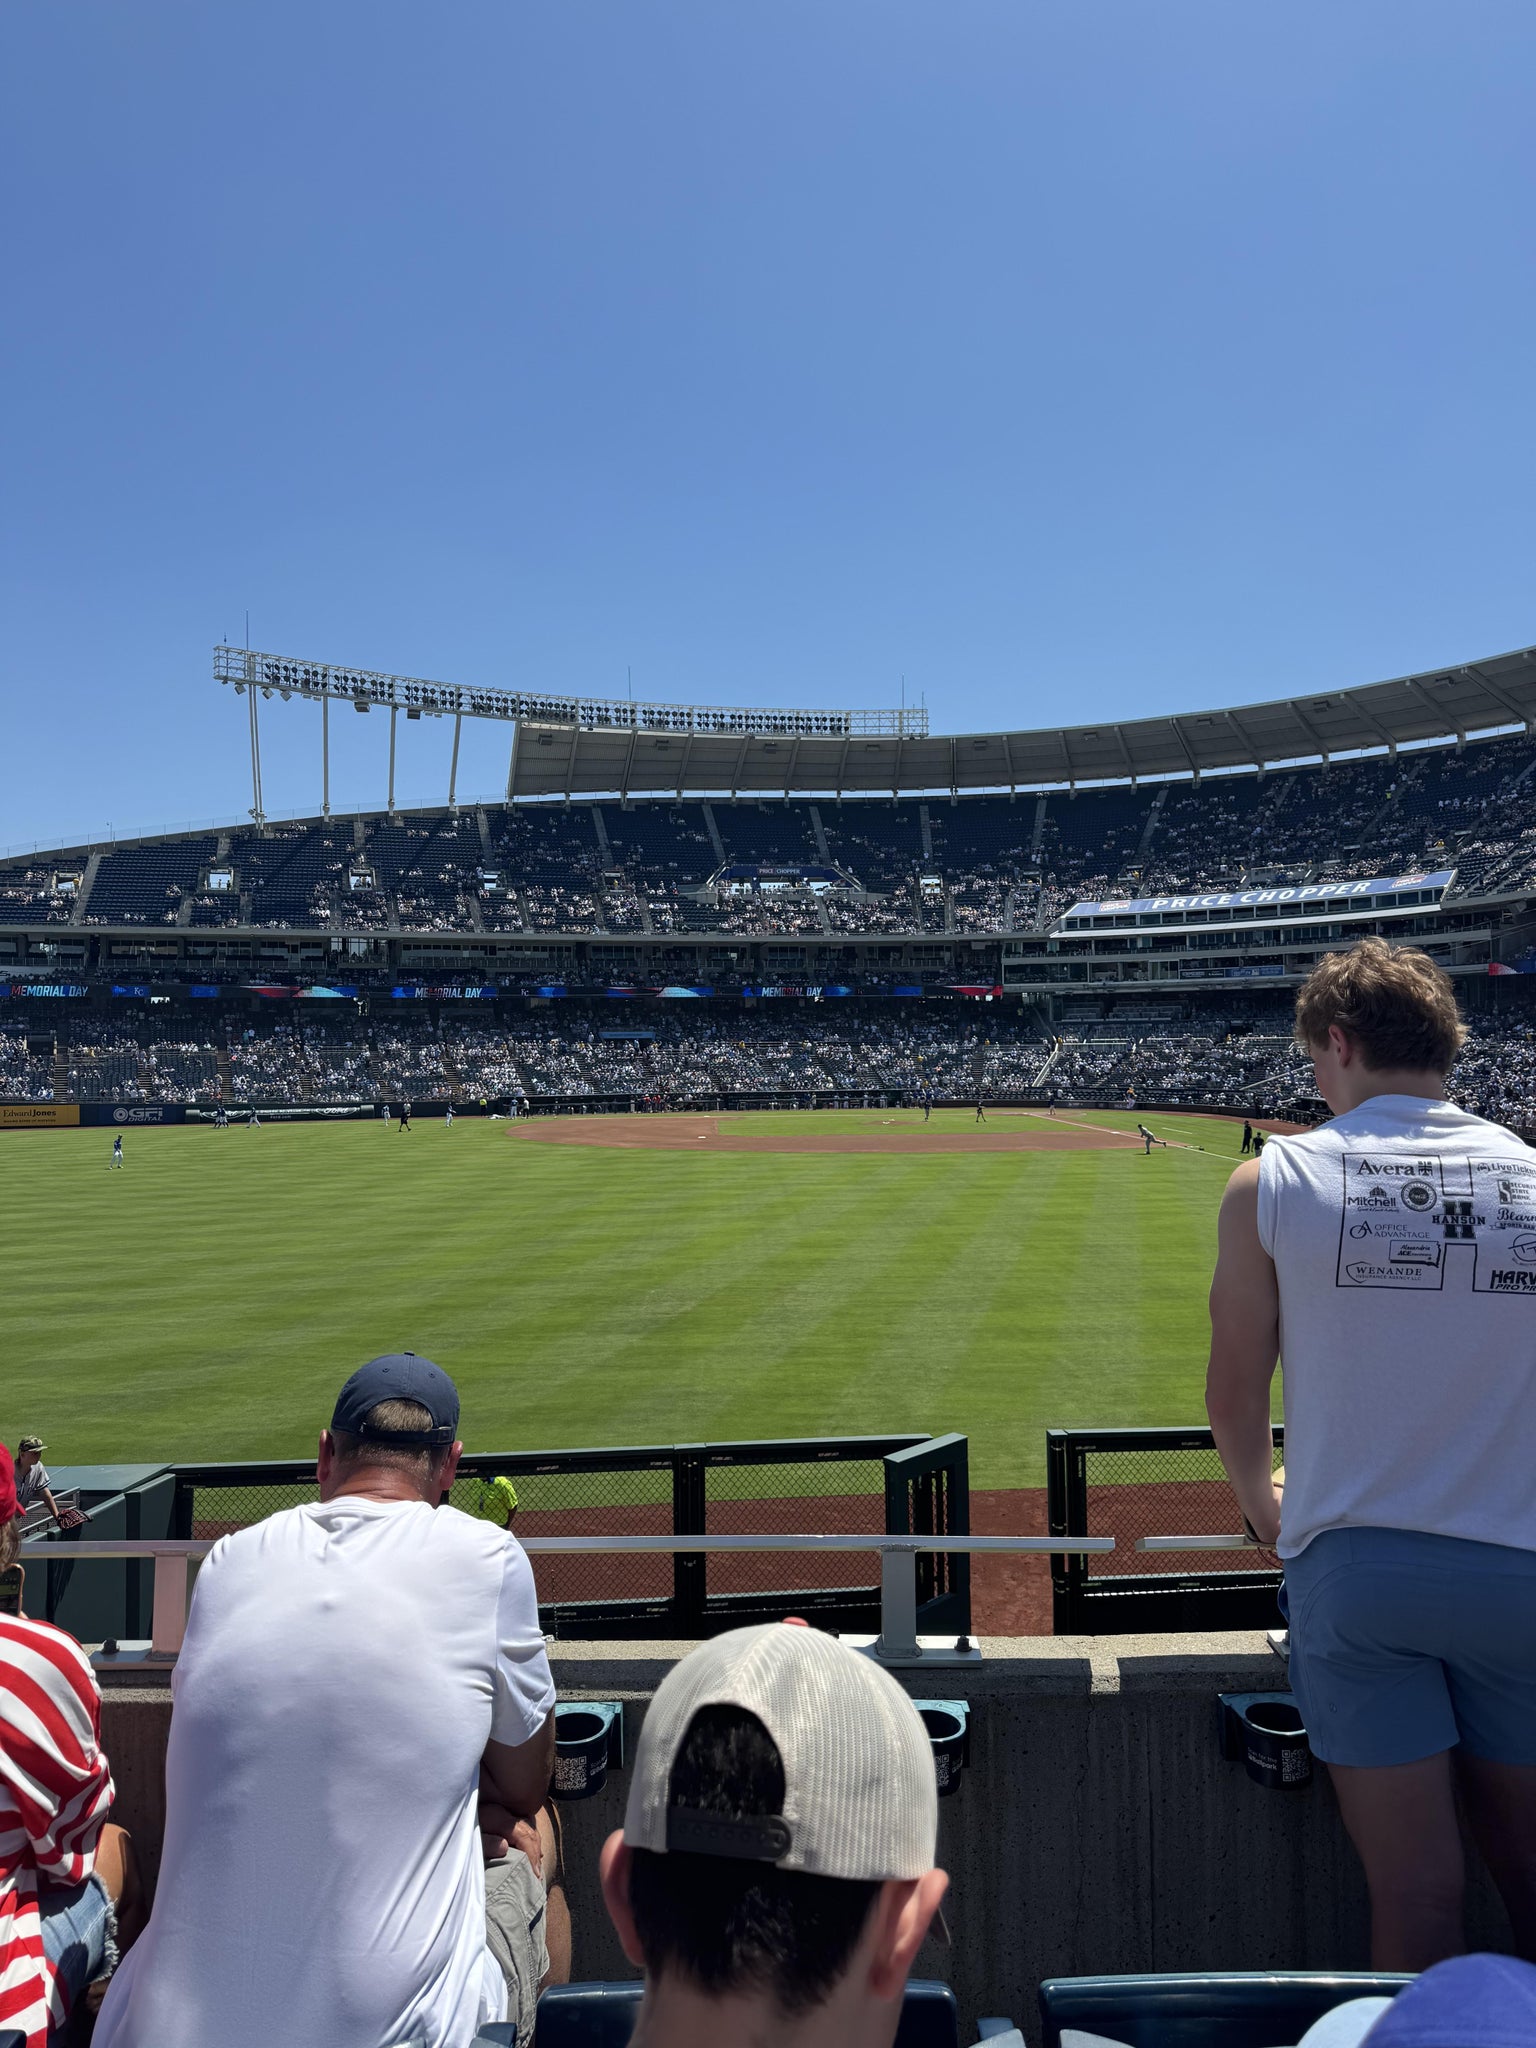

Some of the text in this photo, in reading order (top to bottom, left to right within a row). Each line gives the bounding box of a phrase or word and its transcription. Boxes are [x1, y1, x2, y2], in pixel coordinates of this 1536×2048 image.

[1151, 894, 1234, 910] PRICE
[1241, 882, 1371, 904] CHOPPER
[11, 985, 88, 997] MEMORIAL DAY
[415, 987, 482, 998] MEMORIAL DAY
[762, 986, 822, 997] MEMORIAL DAY
[3, 1109, 57, 1117] Edward Jones
[1357, 1159, 1415, 1176] Avera
[1347, 1196, 1396, 1207] Mitchell
[1432, 1215, 1486, 1225] HANSON
[1356, 1266, 1422, 1276] WENANDE
